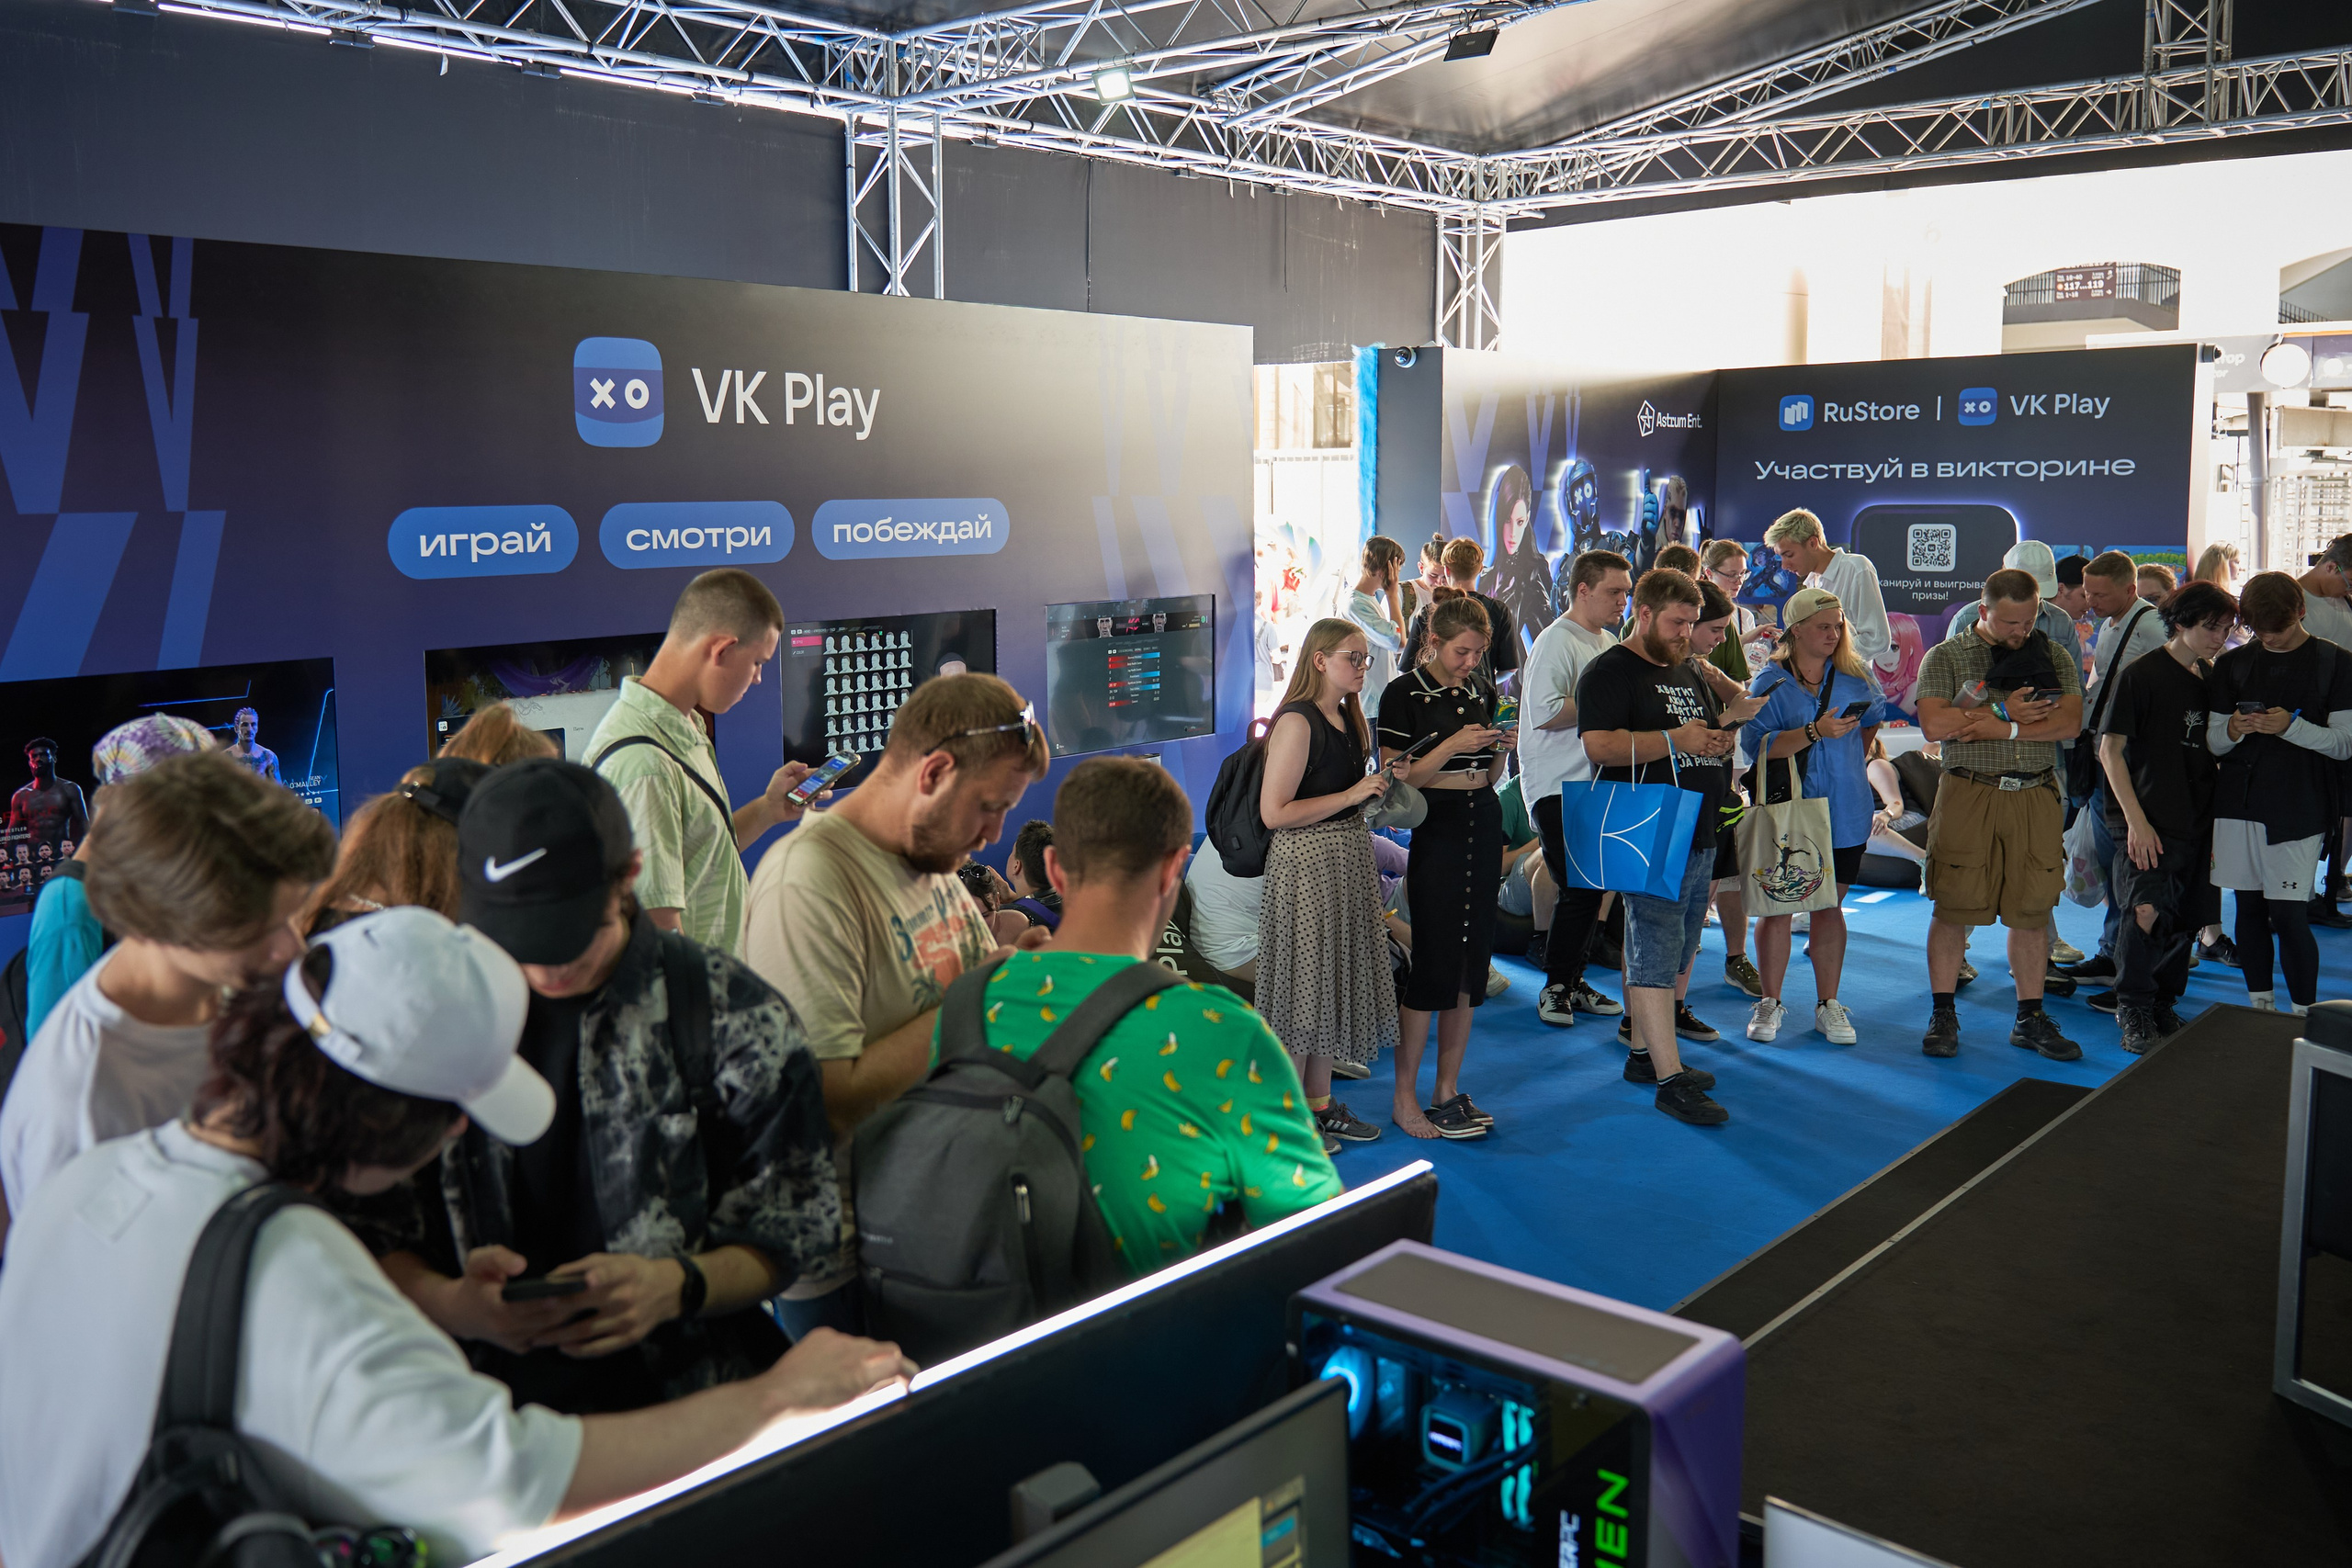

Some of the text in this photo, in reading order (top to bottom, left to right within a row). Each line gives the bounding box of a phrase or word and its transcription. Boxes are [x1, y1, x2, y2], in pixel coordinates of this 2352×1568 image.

[691, 367, 881, 441] VK Play
[1824, 400, 1920, 423] RuStore
[2009, 393, 2110, 419] VK Play
[1656, 412, 1702, 428] Astrum Ent.
[1755, 457, 2136, 483] Участвуй в викторине
[833, 513, 992, 544] побеждай
[419, 521, 551, 562] играй
[626, 524, 772, 554] смотри
[1879, 578, 1921, 589] канируй
[1933, 581, 1985, 590] выигрыва
[1912, 591, 1949, 602] призы!
[1655, 684, 1694, 697] ХВАТИТ
[1666, 704, 1704, 716] ХВАТИТ
[1686, 696, 1696, 706] И
[1679, 757, 1693, 768] JA
